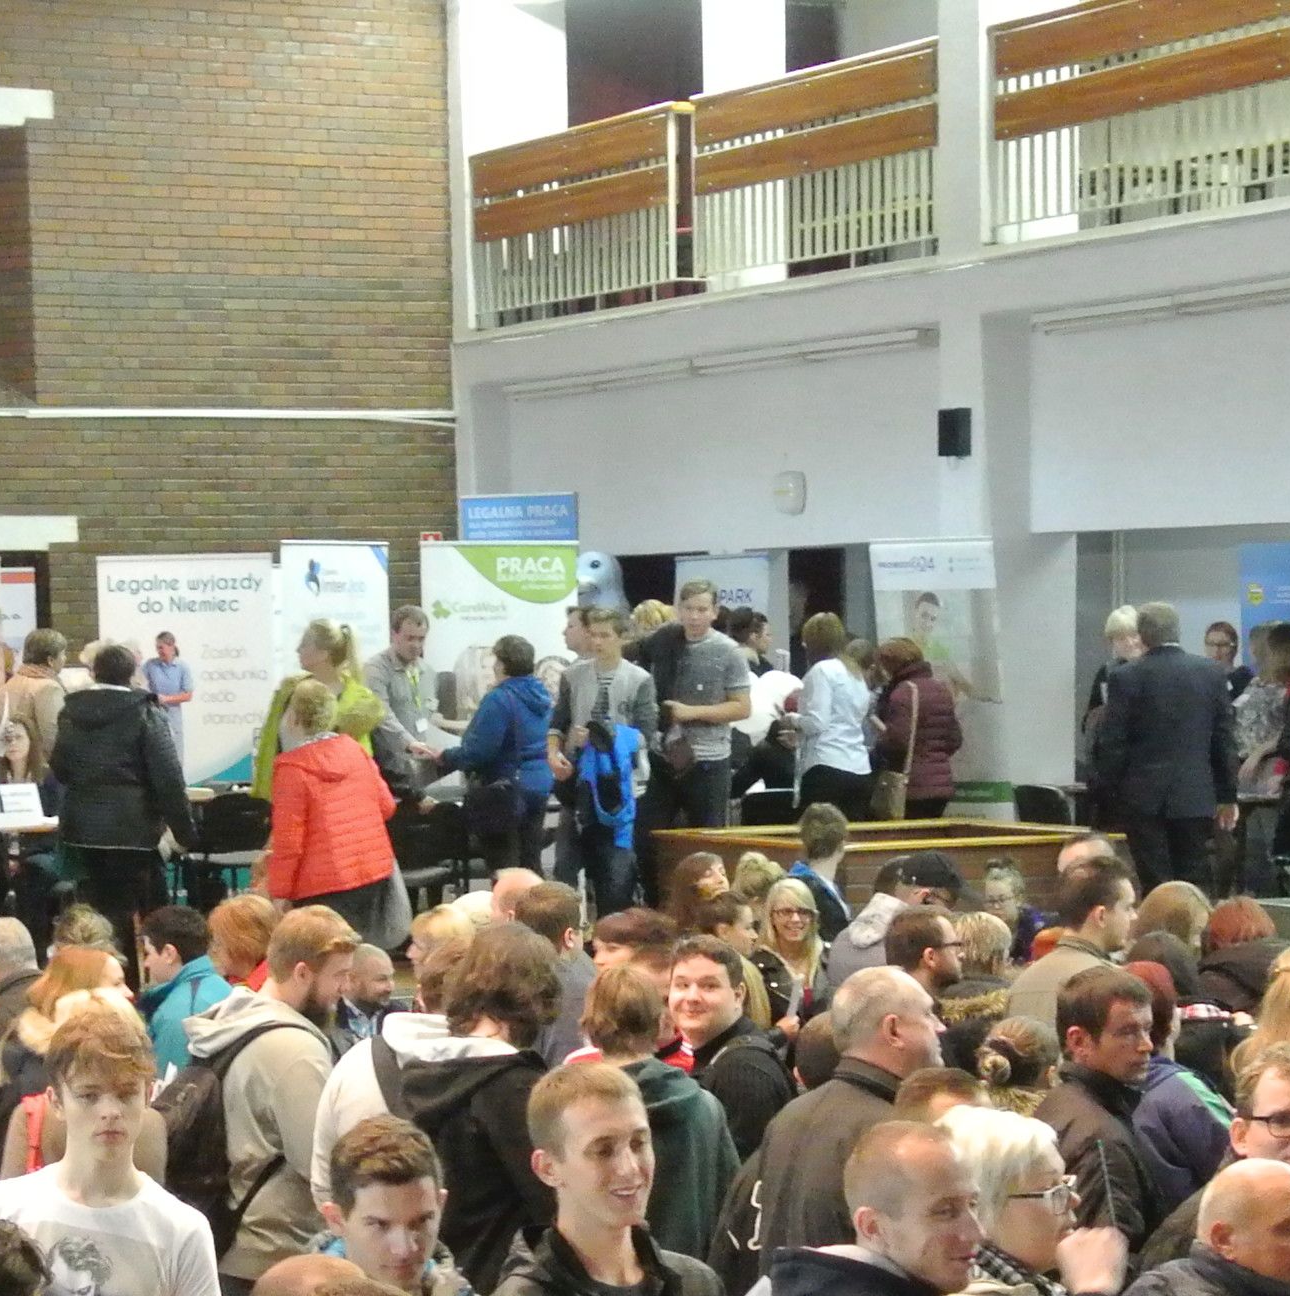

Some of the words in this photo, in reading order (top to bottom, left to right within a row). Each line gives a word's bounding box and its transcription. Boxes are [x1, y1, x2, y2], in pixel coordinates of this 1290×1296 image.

[468, 505, 523, 519] LEGALNA
[527, 504, 568, 517] PRACA
[496, 557, 565, 574] PRACA
[107, 574, 180, 594] Legalne
[187, 573, 263, 593] wyjazdy
[137, 597, 163, 613] do
[169, 596, 240, 613] Niemiec
